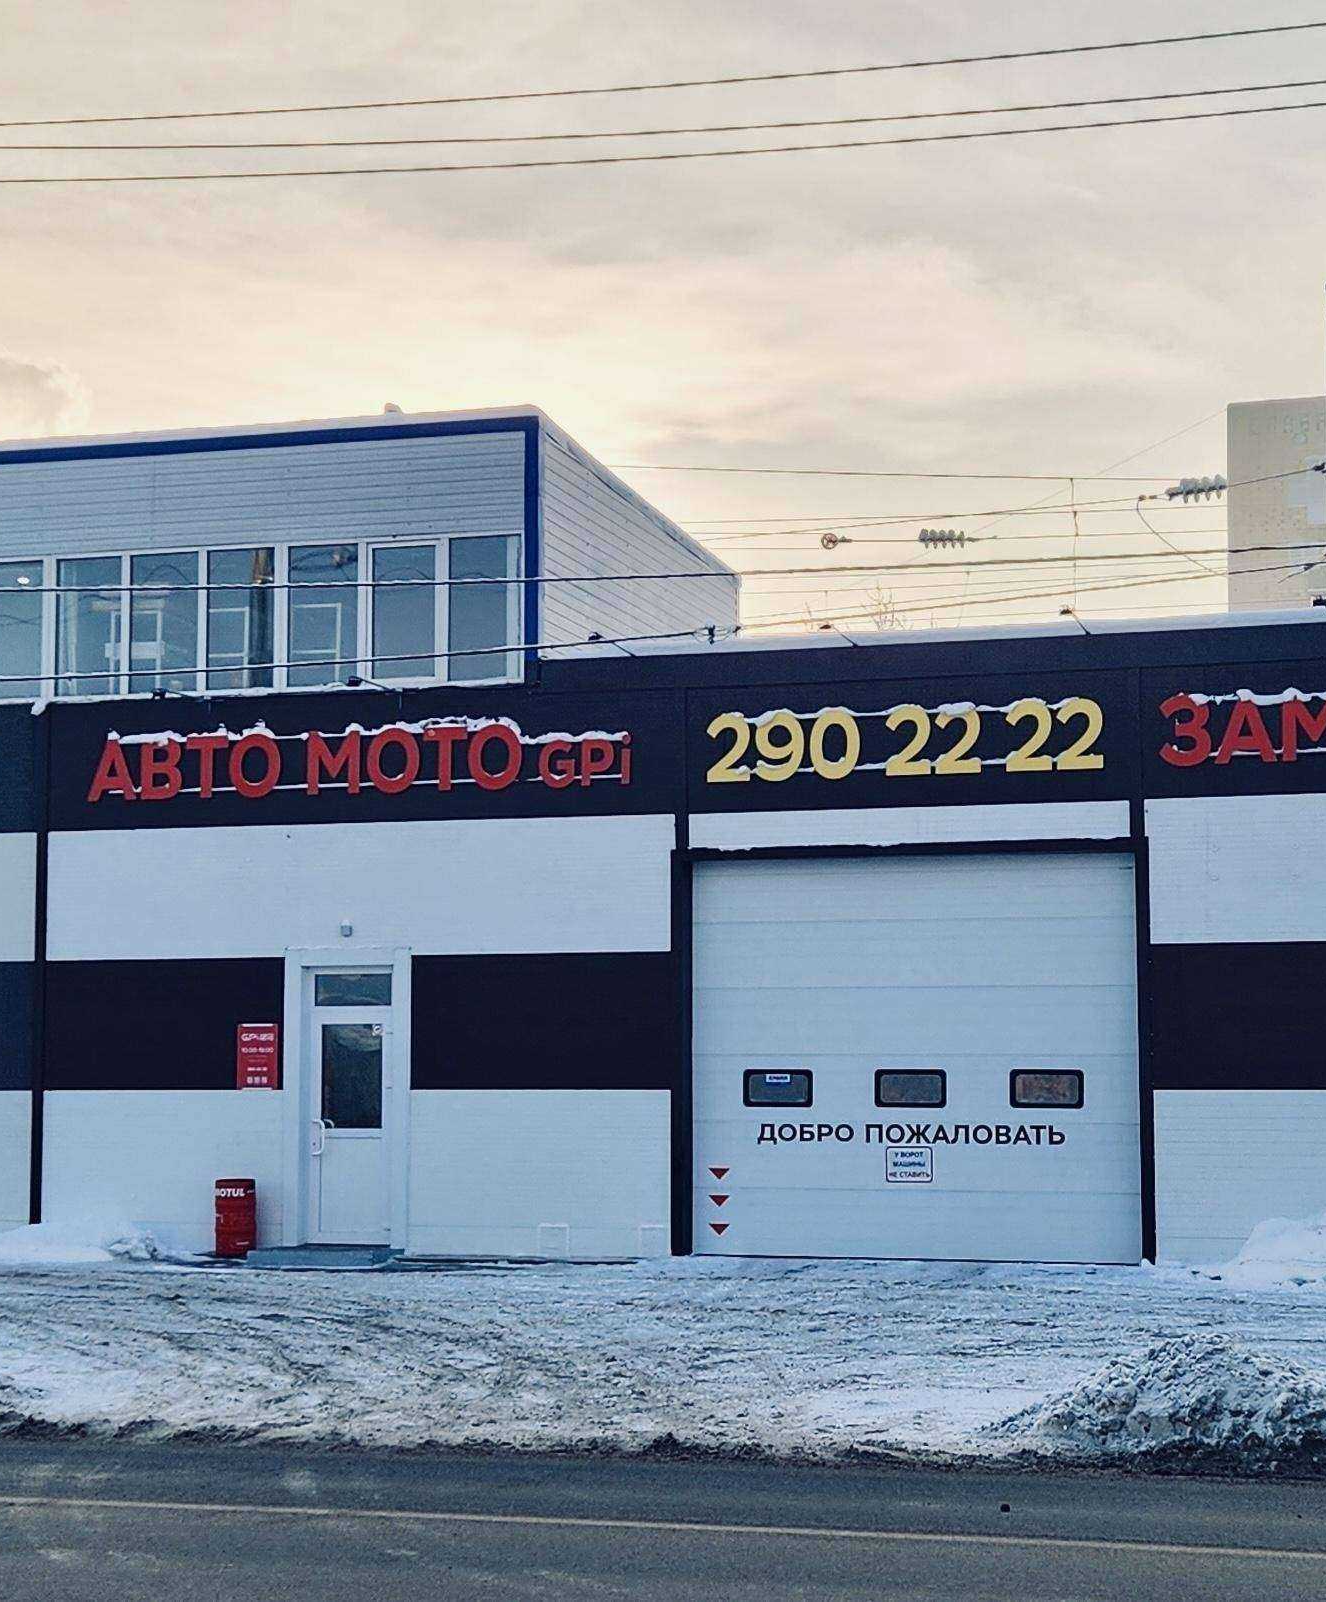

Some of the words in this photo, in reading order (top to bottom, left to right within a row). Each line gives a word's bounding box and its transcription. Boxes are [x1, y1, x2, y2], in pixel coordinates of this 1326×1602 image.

[86, 732, 281, 802] АВТО
[306, 724, 523, 796] МОТО
[538, 732, 632, 789] GPi
[706, 707, 861, 783] 290
[885, 704, 982, 777] 22
[1005, 698, 1105, 773] 22
[757, 1123, 855, 1145] ДОБРО
[865, 1123, 1066, 1146] ПОЖАЛОВАТЬ
